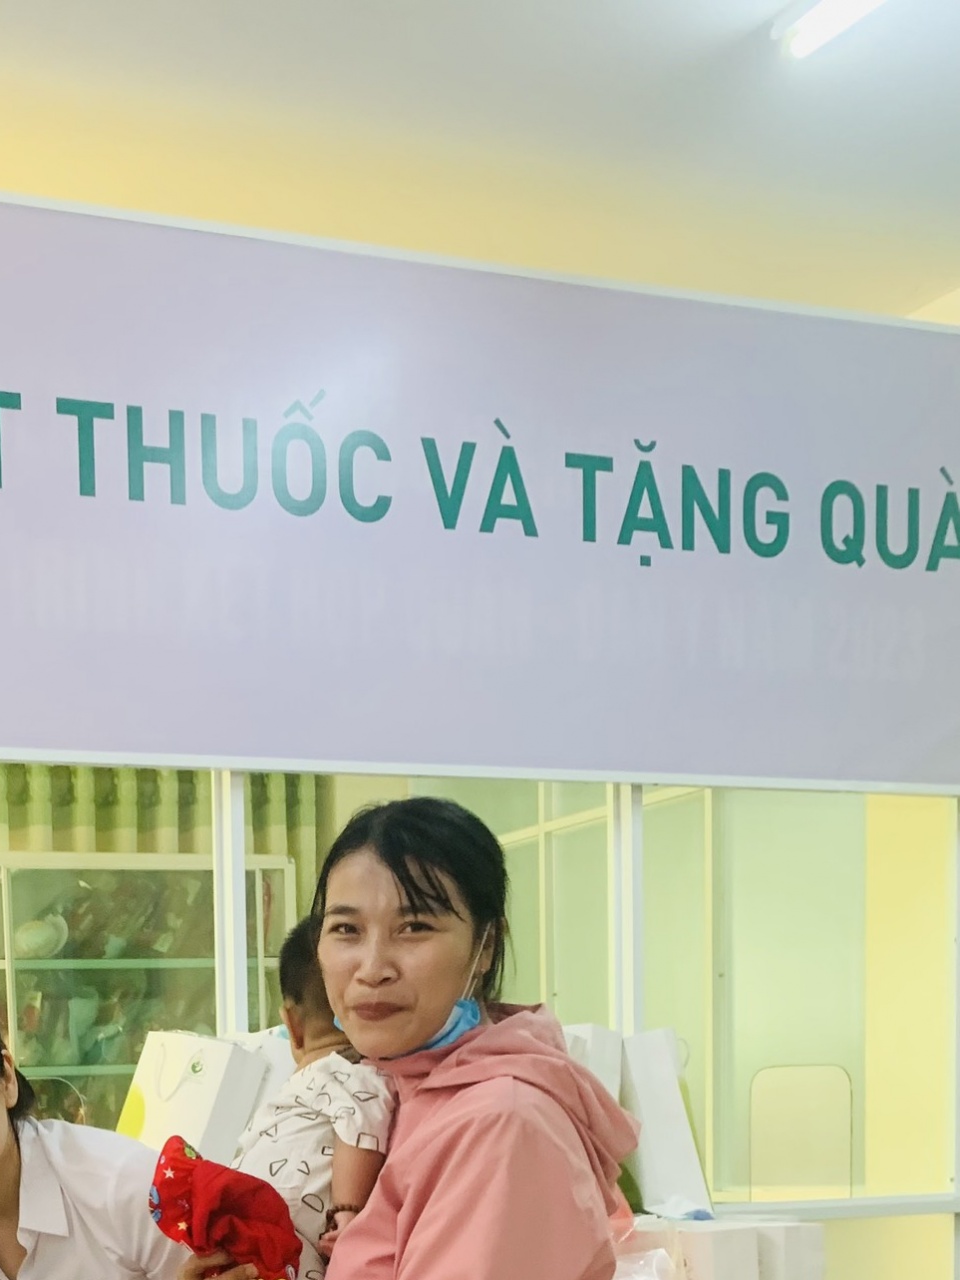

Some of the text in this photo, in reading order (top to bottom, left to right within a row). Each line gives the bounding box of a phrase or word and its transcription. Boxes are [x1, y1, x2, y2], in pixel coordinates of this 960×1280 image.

[55, 388, 393, 523] THUỐC
[421, 418, 539, 538] VÀ
[565, 439, 791, 567] TẶNG
